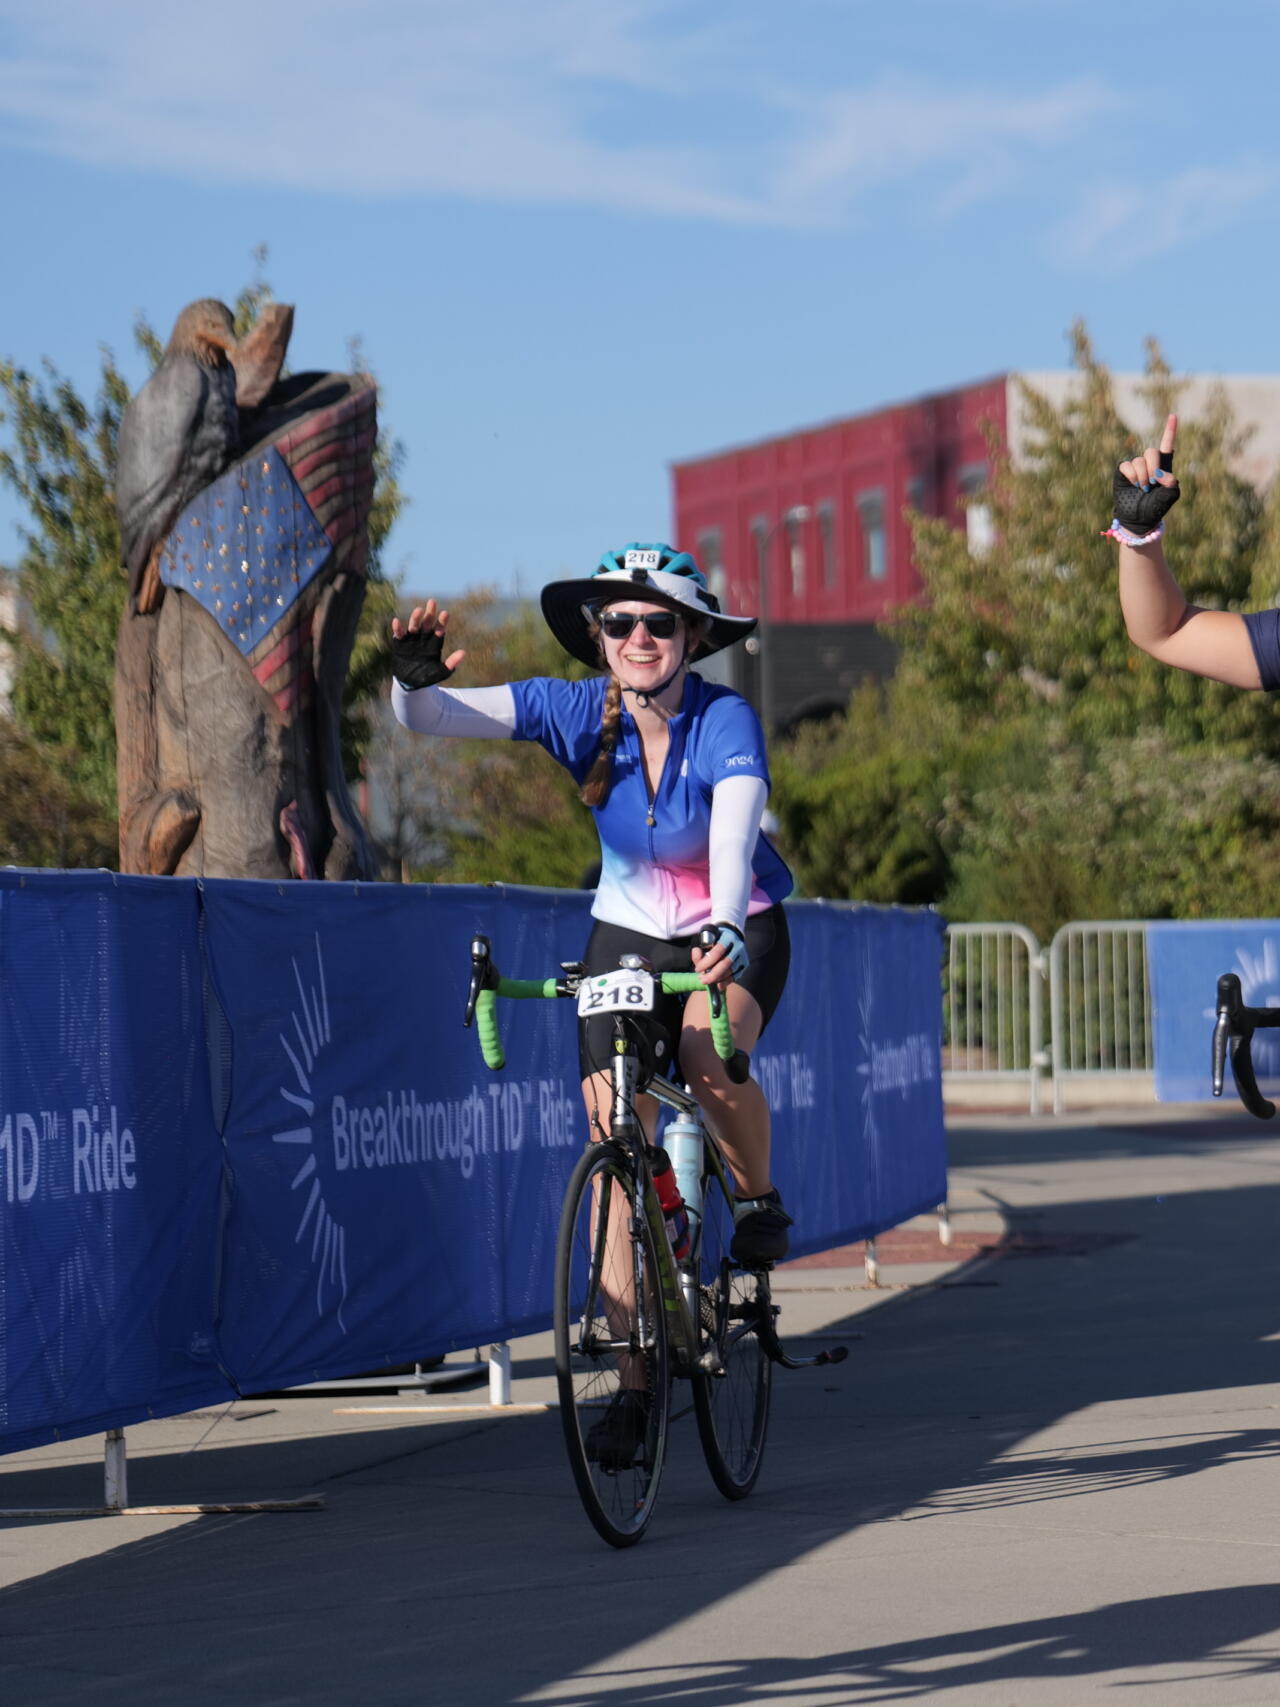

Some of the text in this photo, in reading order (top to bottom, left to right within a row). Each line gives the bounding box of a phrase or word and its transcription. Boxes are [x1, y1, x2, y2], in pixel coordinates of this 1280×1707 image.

[628, 552, 656, 563] 218
[587, 985, 644, 1010] 218
[790, 1052, 815, 1109] Ride
[72, 1105, 137, 1194] Ride
[332, 1089, 487, 1179] Breakthrough
[539, 1077, 575, 1147] Ride
